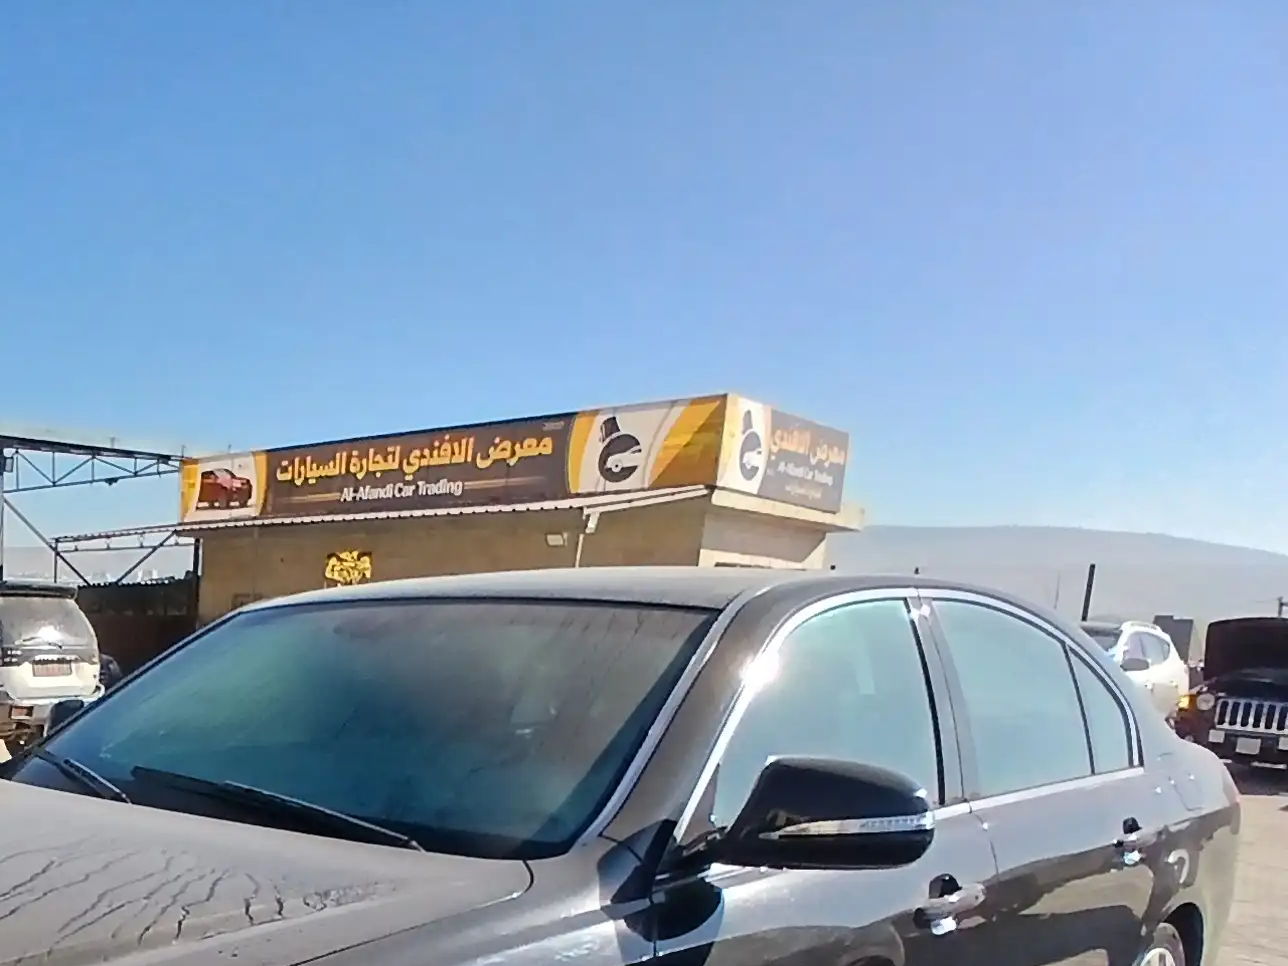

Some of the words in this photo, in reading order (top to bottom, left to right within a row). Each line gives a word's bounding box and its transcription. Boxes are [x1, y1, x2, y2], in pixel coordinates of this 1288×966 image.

[349, 445, 401, 479] لتجارة
[402, 434, 475, 481] الافندي
[476, 435, 553, 468] معرض
[276, 452, 346, 486] السيارات
[341, 483, 393, 502] Al-Afandi
[394, 482, 415, 498] Car
[417, 478, 463, 496] Trading
